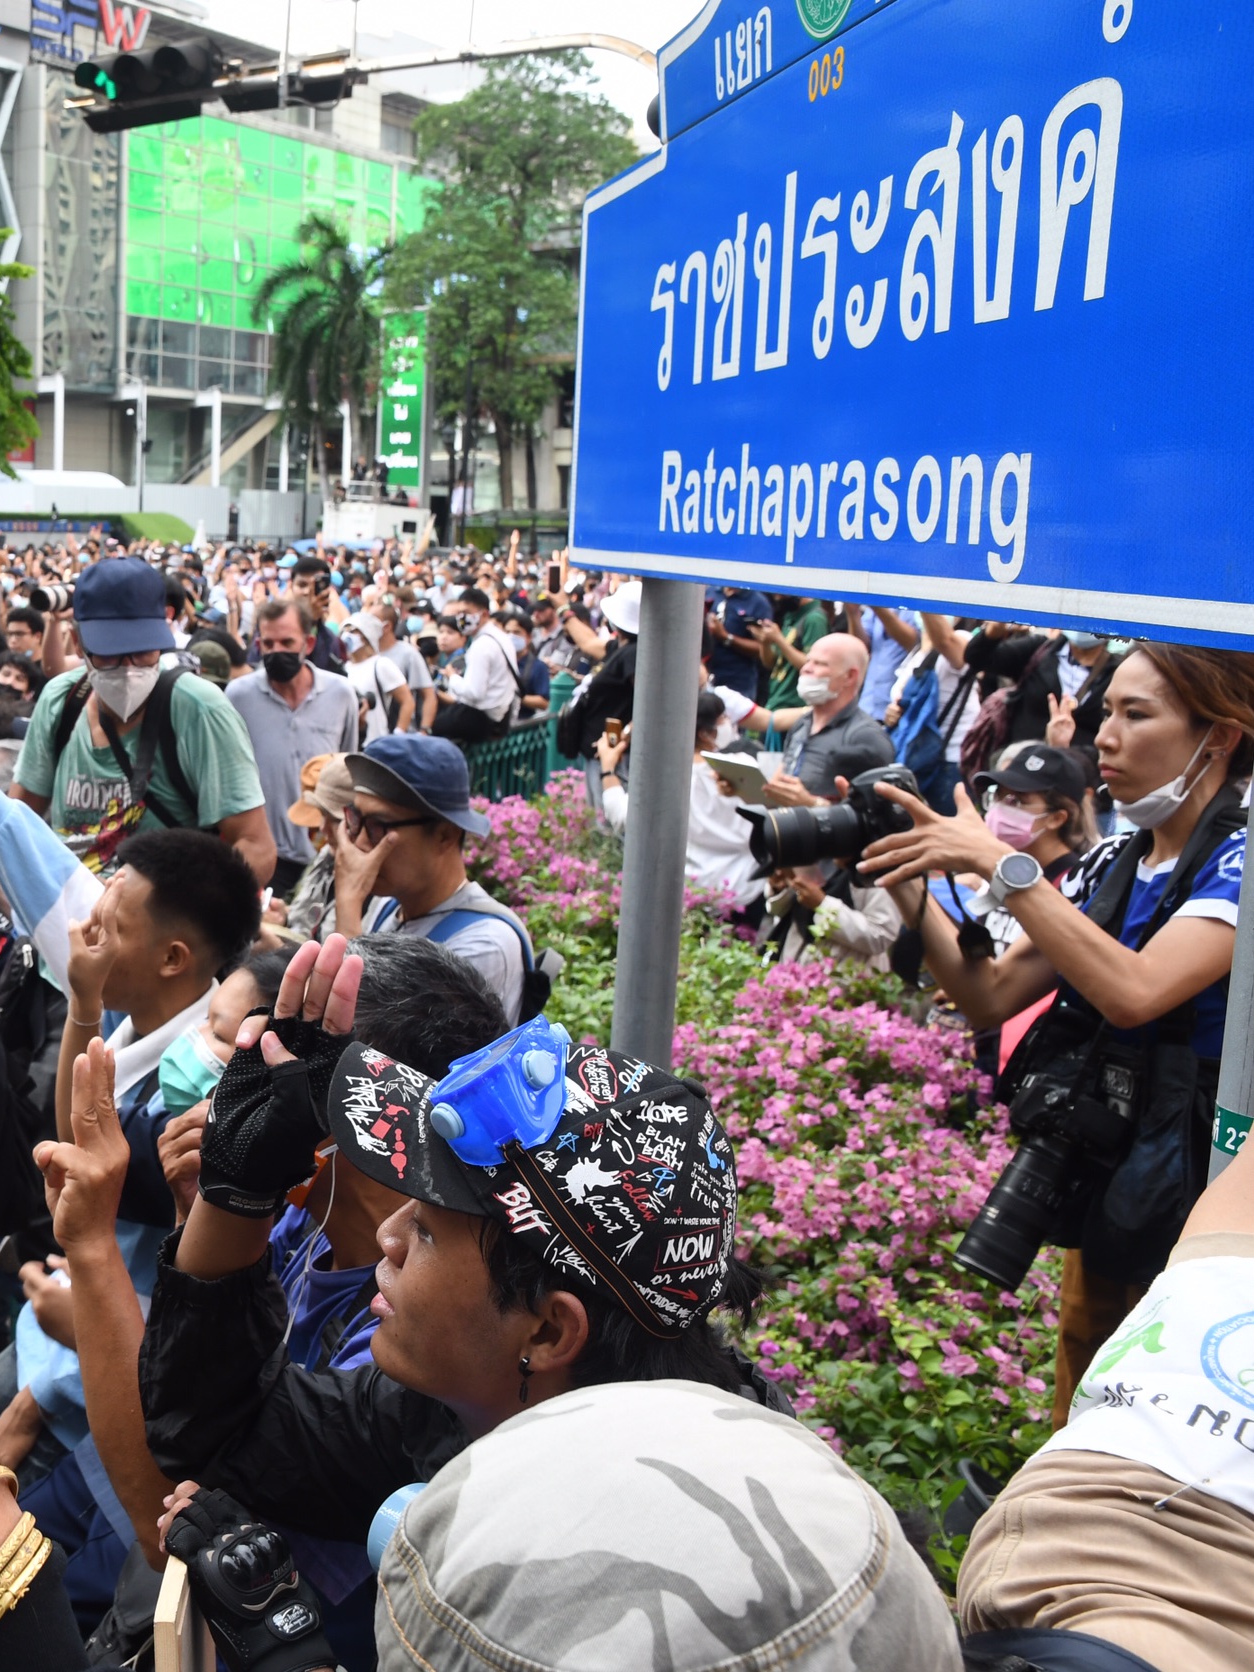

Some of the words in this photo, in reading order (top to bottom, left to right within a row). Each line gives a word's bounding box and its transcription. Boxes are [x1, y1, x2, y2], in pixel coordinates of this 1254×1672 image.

[714, 6, 772, 100] แยก
[808, 46, 845, 103] 003
[658, 443, 1032, 583] Ratchaprasong
[417, 1109, 426, 1143] Remember
[636, 1100, 689, 1126] HOPE
[583, 1123, 604, 1139] BYE
[645, 1125, 687, 1151] BLAH
[635, 1133, 678, 1159] BLAH
[641, 1146, 684, 1171] BLAH
[692, 1161, 709, 1175] make
[690, 1180, 719, 1214] true
[584, 1196, 623, 1234] heart
[605, 1196, 642, 1232] your
[662, 1233, 714, 1265] NOW
[650, 1273, 673, 1286] or
[678, 1262, 720, 1284] never
[651, 1293, 681, 1314] JUDGE
[676, 1307, 693, 1319] ME
